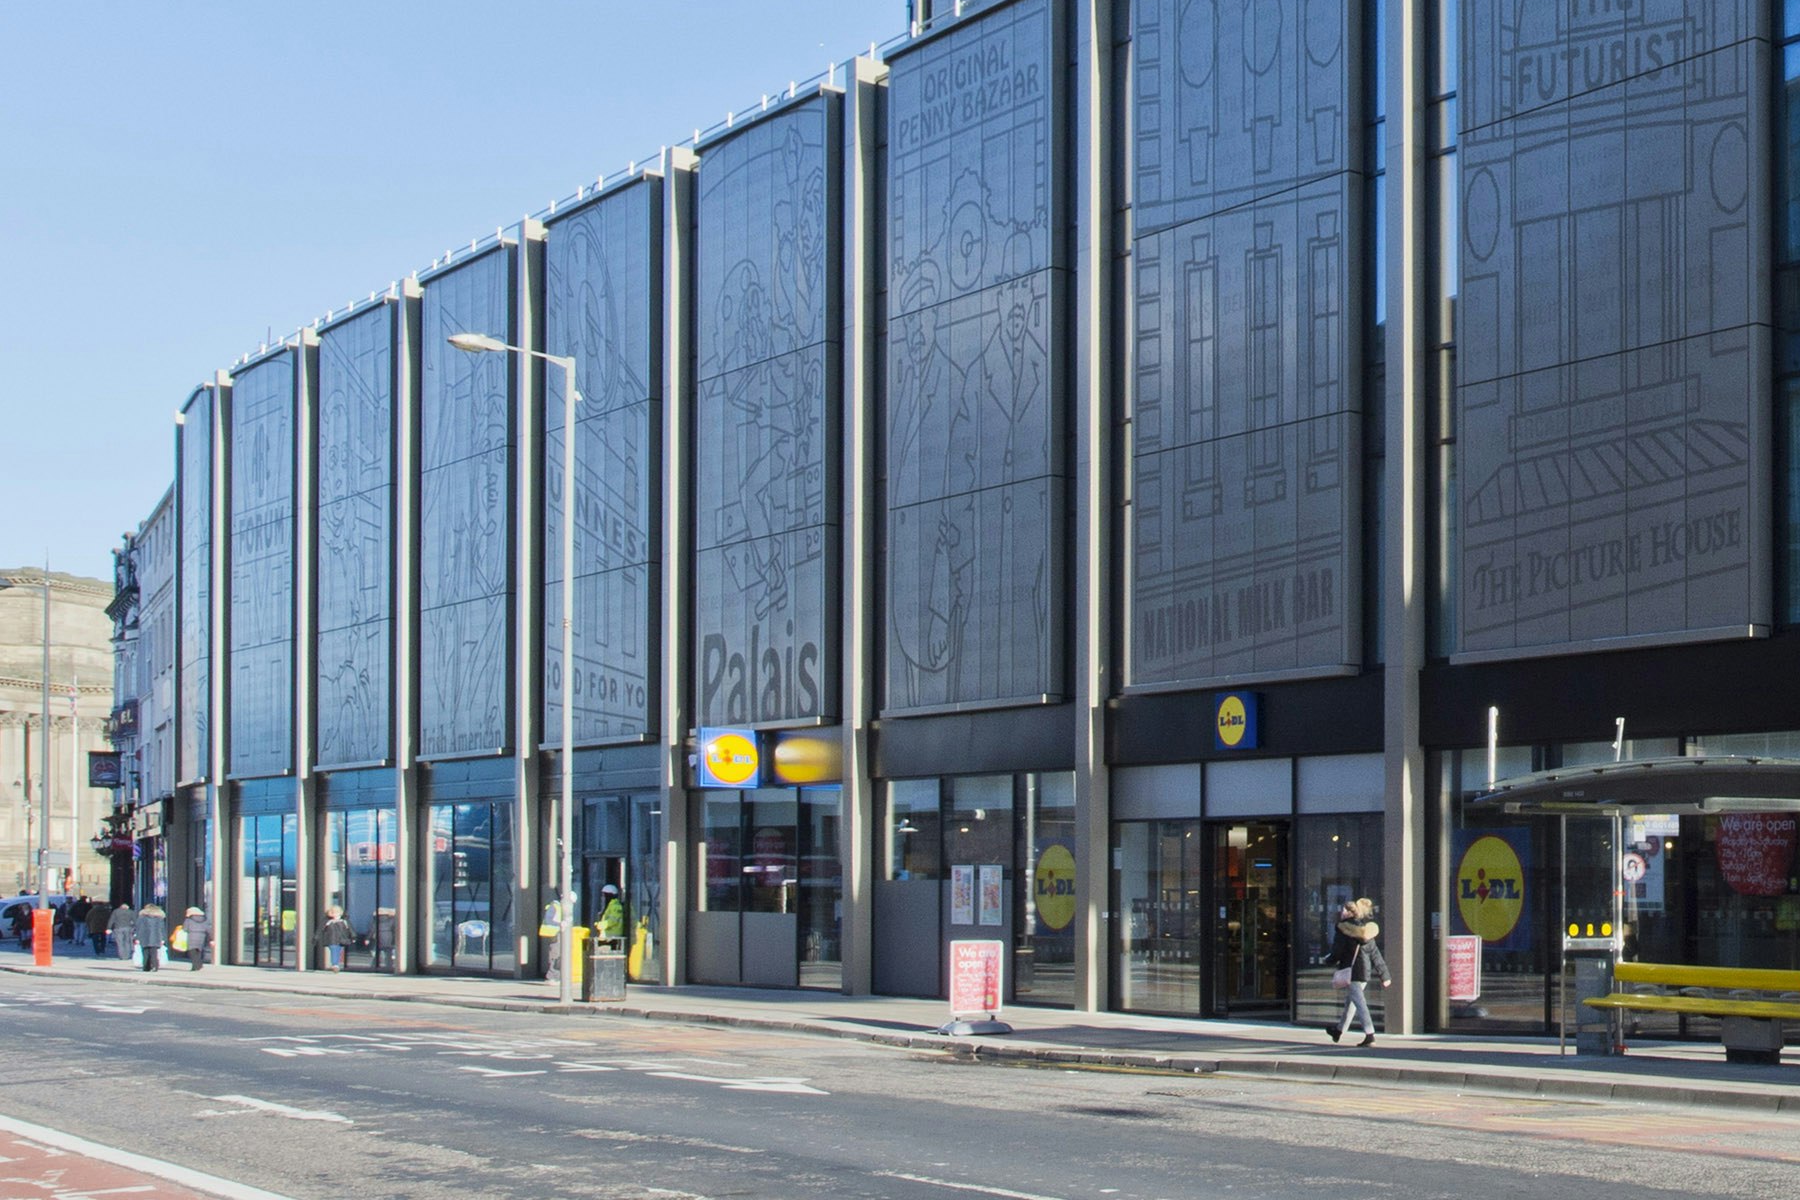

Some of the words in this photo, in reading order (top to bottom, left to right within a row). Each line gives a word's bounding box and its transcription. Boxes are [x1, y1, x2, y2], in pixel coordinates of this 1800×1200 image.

[924, 39, 1009, 103] ORIGINAL
[1517, 28, 1687, 104] FUTURIST
[898, 102, 957, 150] PENNY
[962, 63, 1040, 122] BAZAAR
[239, 505, 285, 557] FORUM
[1527, 533, 1642, 598] PICTURE
[1650, 506, 1742, 568] HOUSE
[1143, 591, 1232, 662] NATIONAL
[1238, 578, 1286, 637] MILK
[1293, 567, 1334, 625] BAR
[589, 670, 618, 704] FOR
[702, 618, 818, 727] Palais
[450, 720, 502, 753] American
[1720, 816, 1740, 831] We
[1743, 819, 1762, 832] are
[1766, 819, 1796, 834] open
[958, 947, 977, 958] We
[978, 949, 996, 958] are
[958, 960, 984, 972] open
